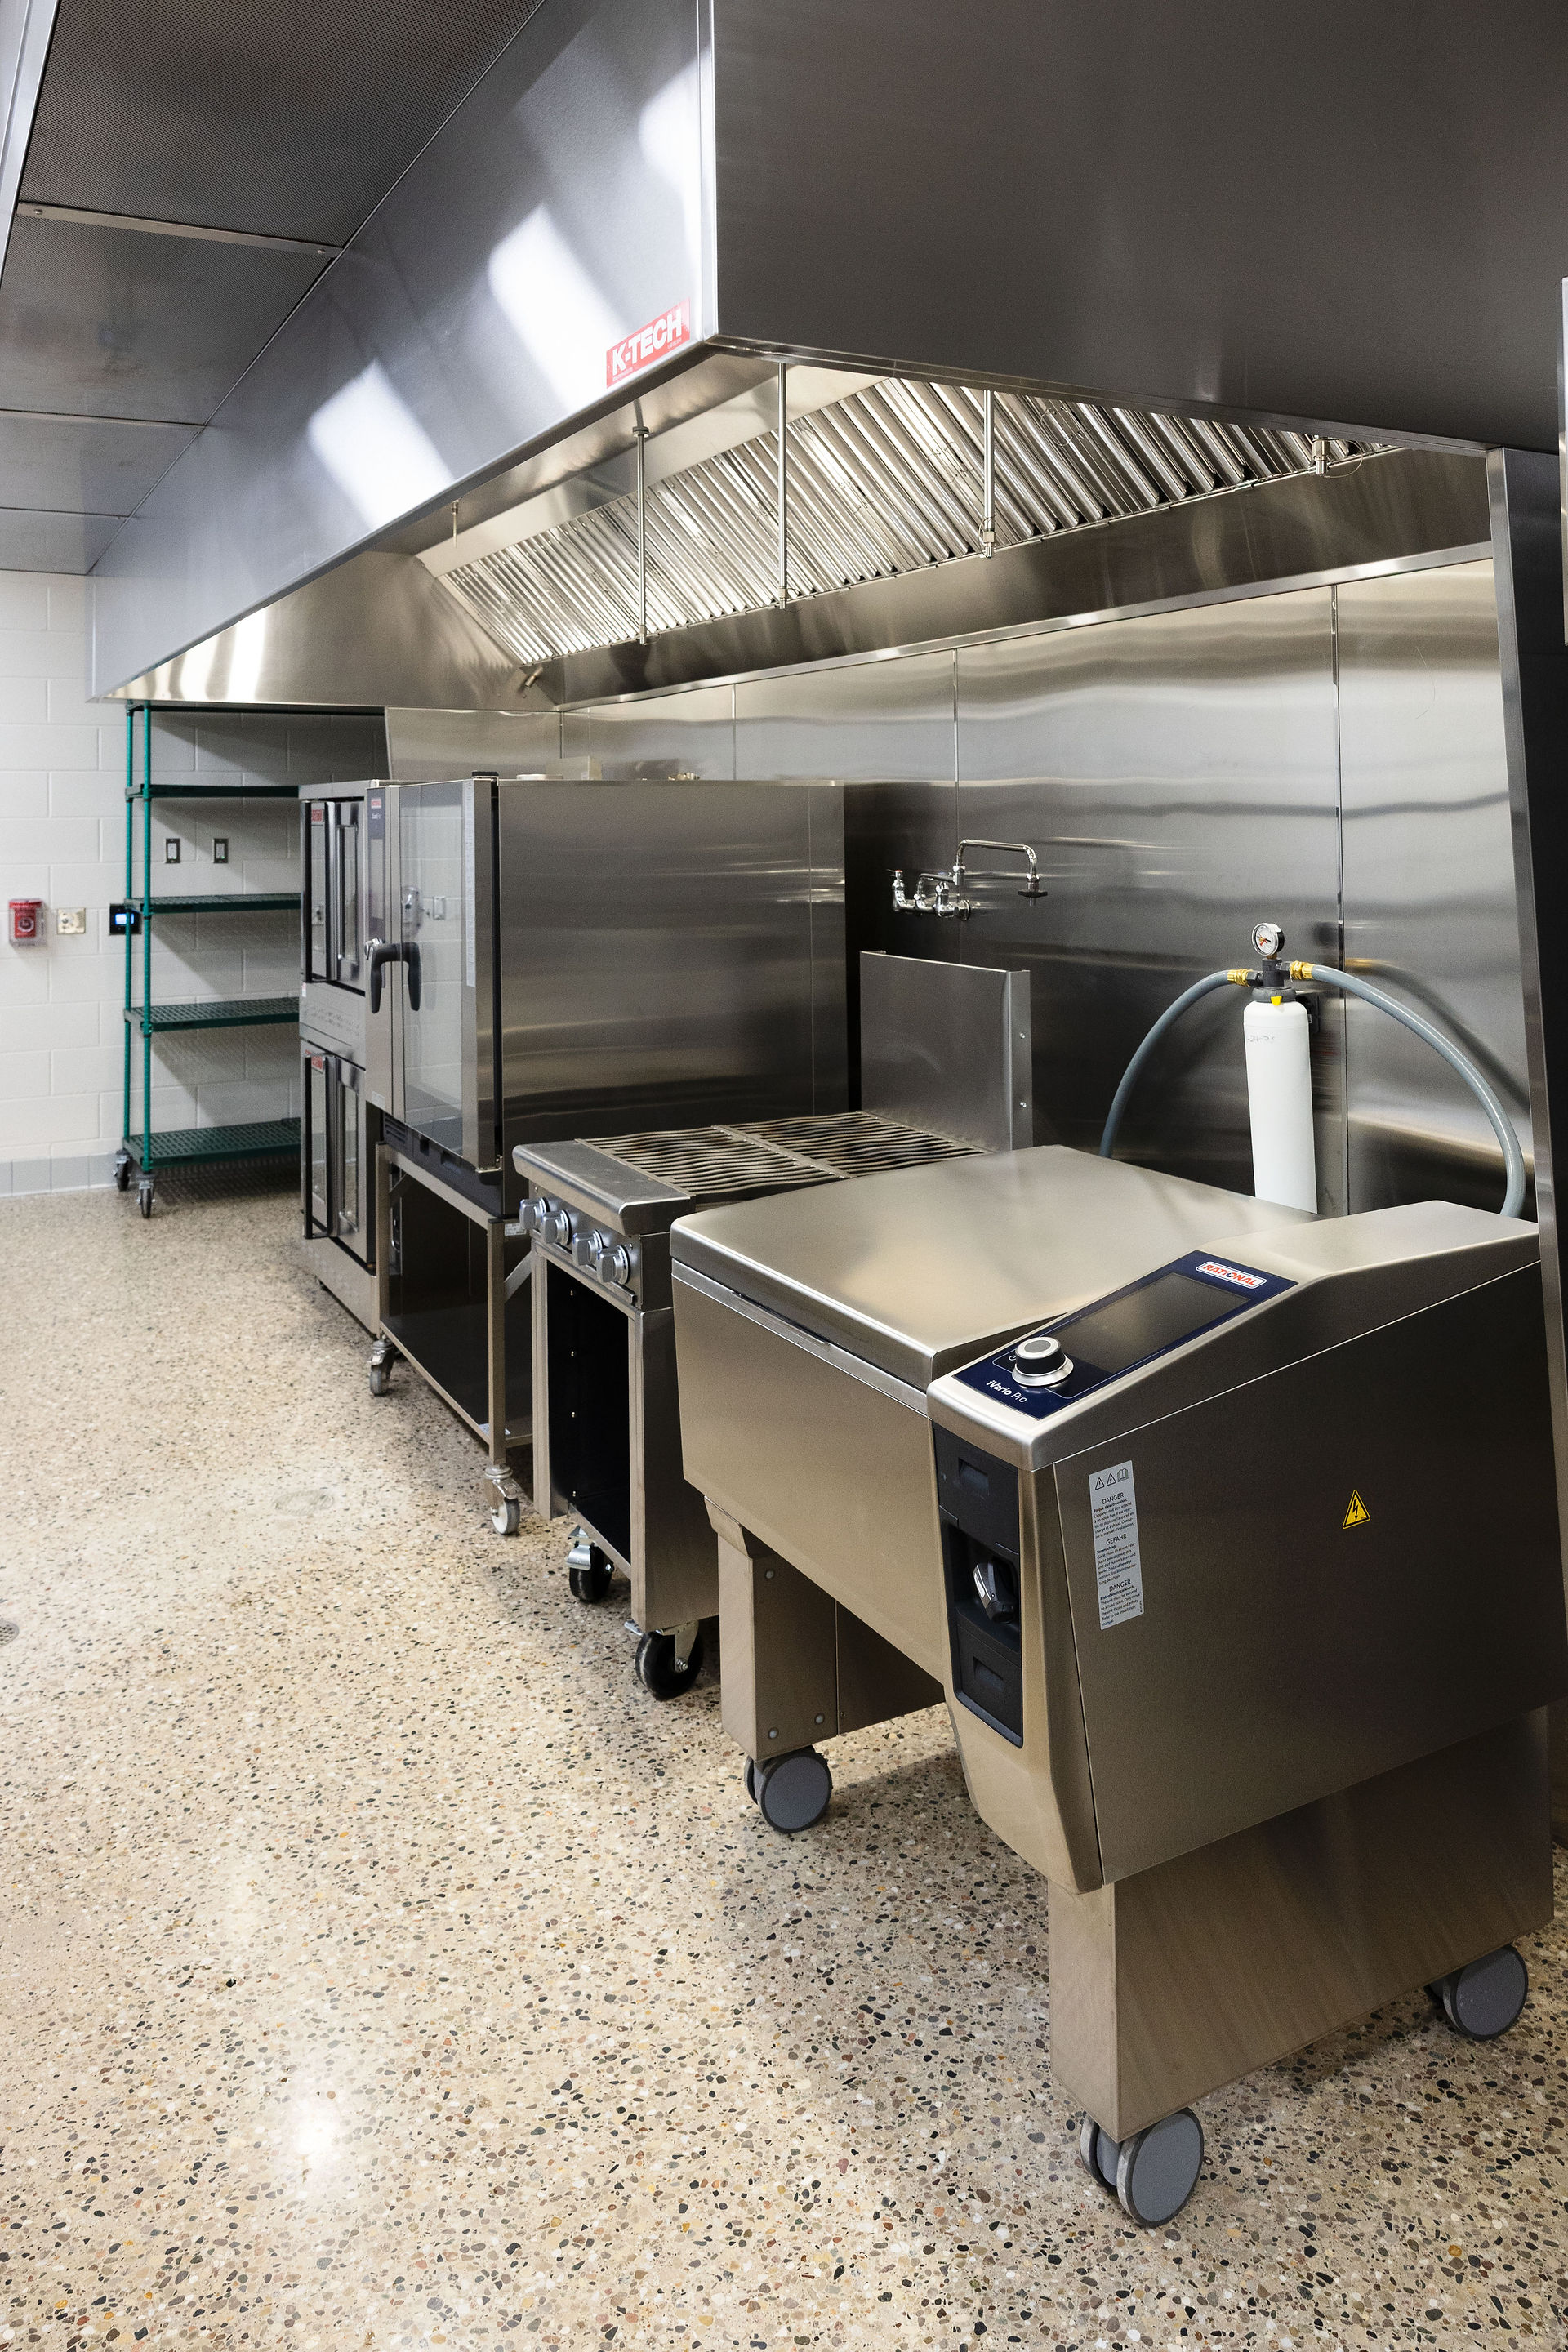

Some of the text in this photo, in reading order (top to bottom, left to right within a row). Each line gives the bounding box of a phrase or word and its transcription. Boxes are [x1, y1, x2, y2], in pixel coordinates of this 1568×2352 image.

[612, 308, 682, 376] K-TECH
[1202, 1264, 1258, 1286] RATIONAL
[986, 1379, 1027, 1403] iVario Pro
[1102, 1492, 1124, 1504] DANGER
[1106, 1533, 1127, 1545] GEFAHR
[1109, 1579, 1131, 1592] DANGER
